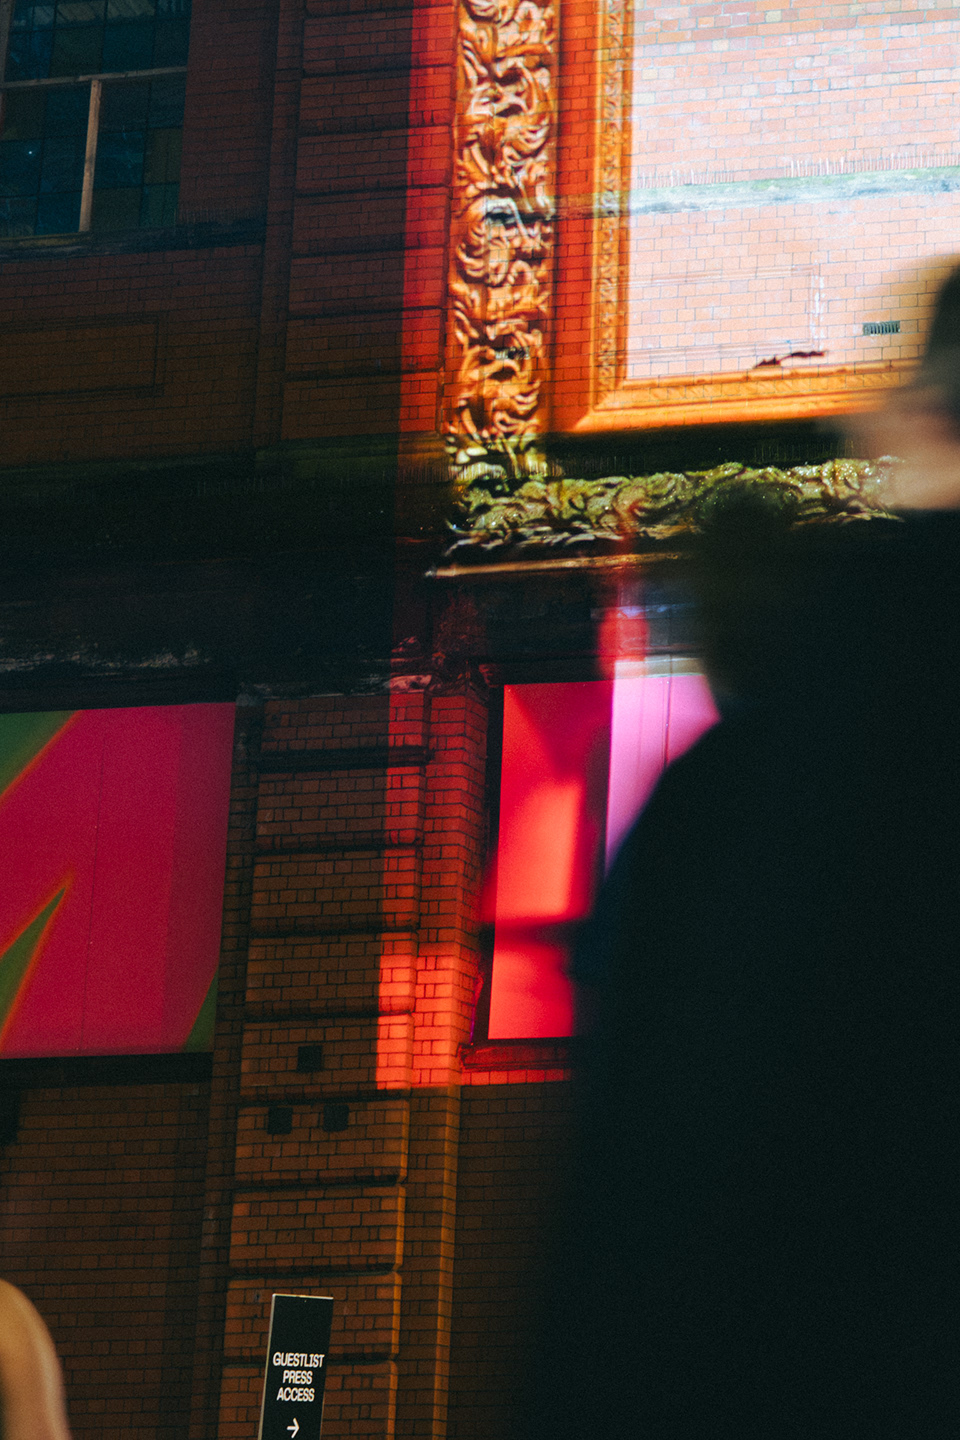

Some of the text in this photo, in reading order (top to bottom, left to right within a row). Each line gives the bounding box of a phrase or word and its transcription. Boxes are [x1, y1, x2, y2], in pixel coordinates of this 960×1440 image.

[272, 1351, 325, 1368] GUESTLIST
[282, 1370, 313, 1385] PRESS
[276, 1387, 316, 1402] ACCESS
